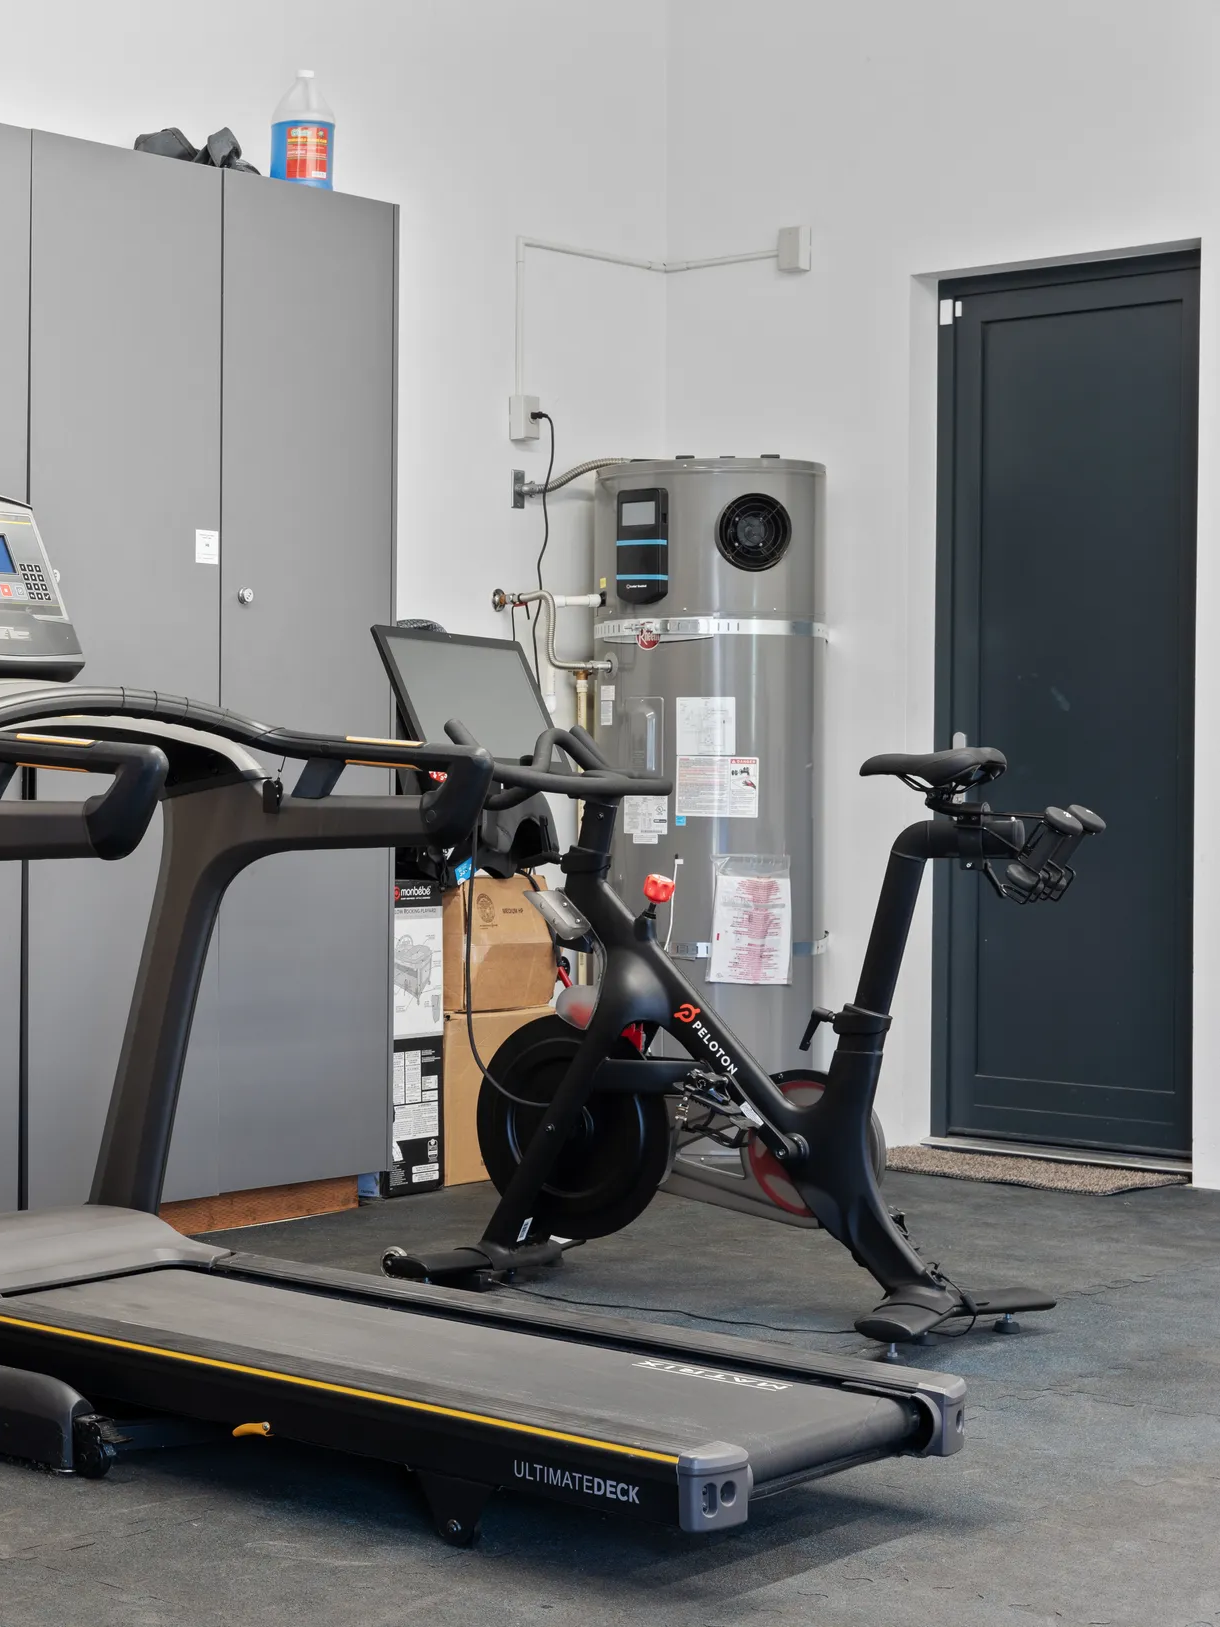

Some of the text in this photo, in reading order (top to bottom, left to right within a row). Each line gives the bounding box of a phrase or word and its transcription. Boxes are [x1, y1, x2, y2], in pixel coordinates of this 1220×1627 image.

[691, 1020, 738, 1075] PELOTON
[639, 1360, 789, 1391] MATRIX
[513, 1459, 640, 1504] ULTIMATEDECK
